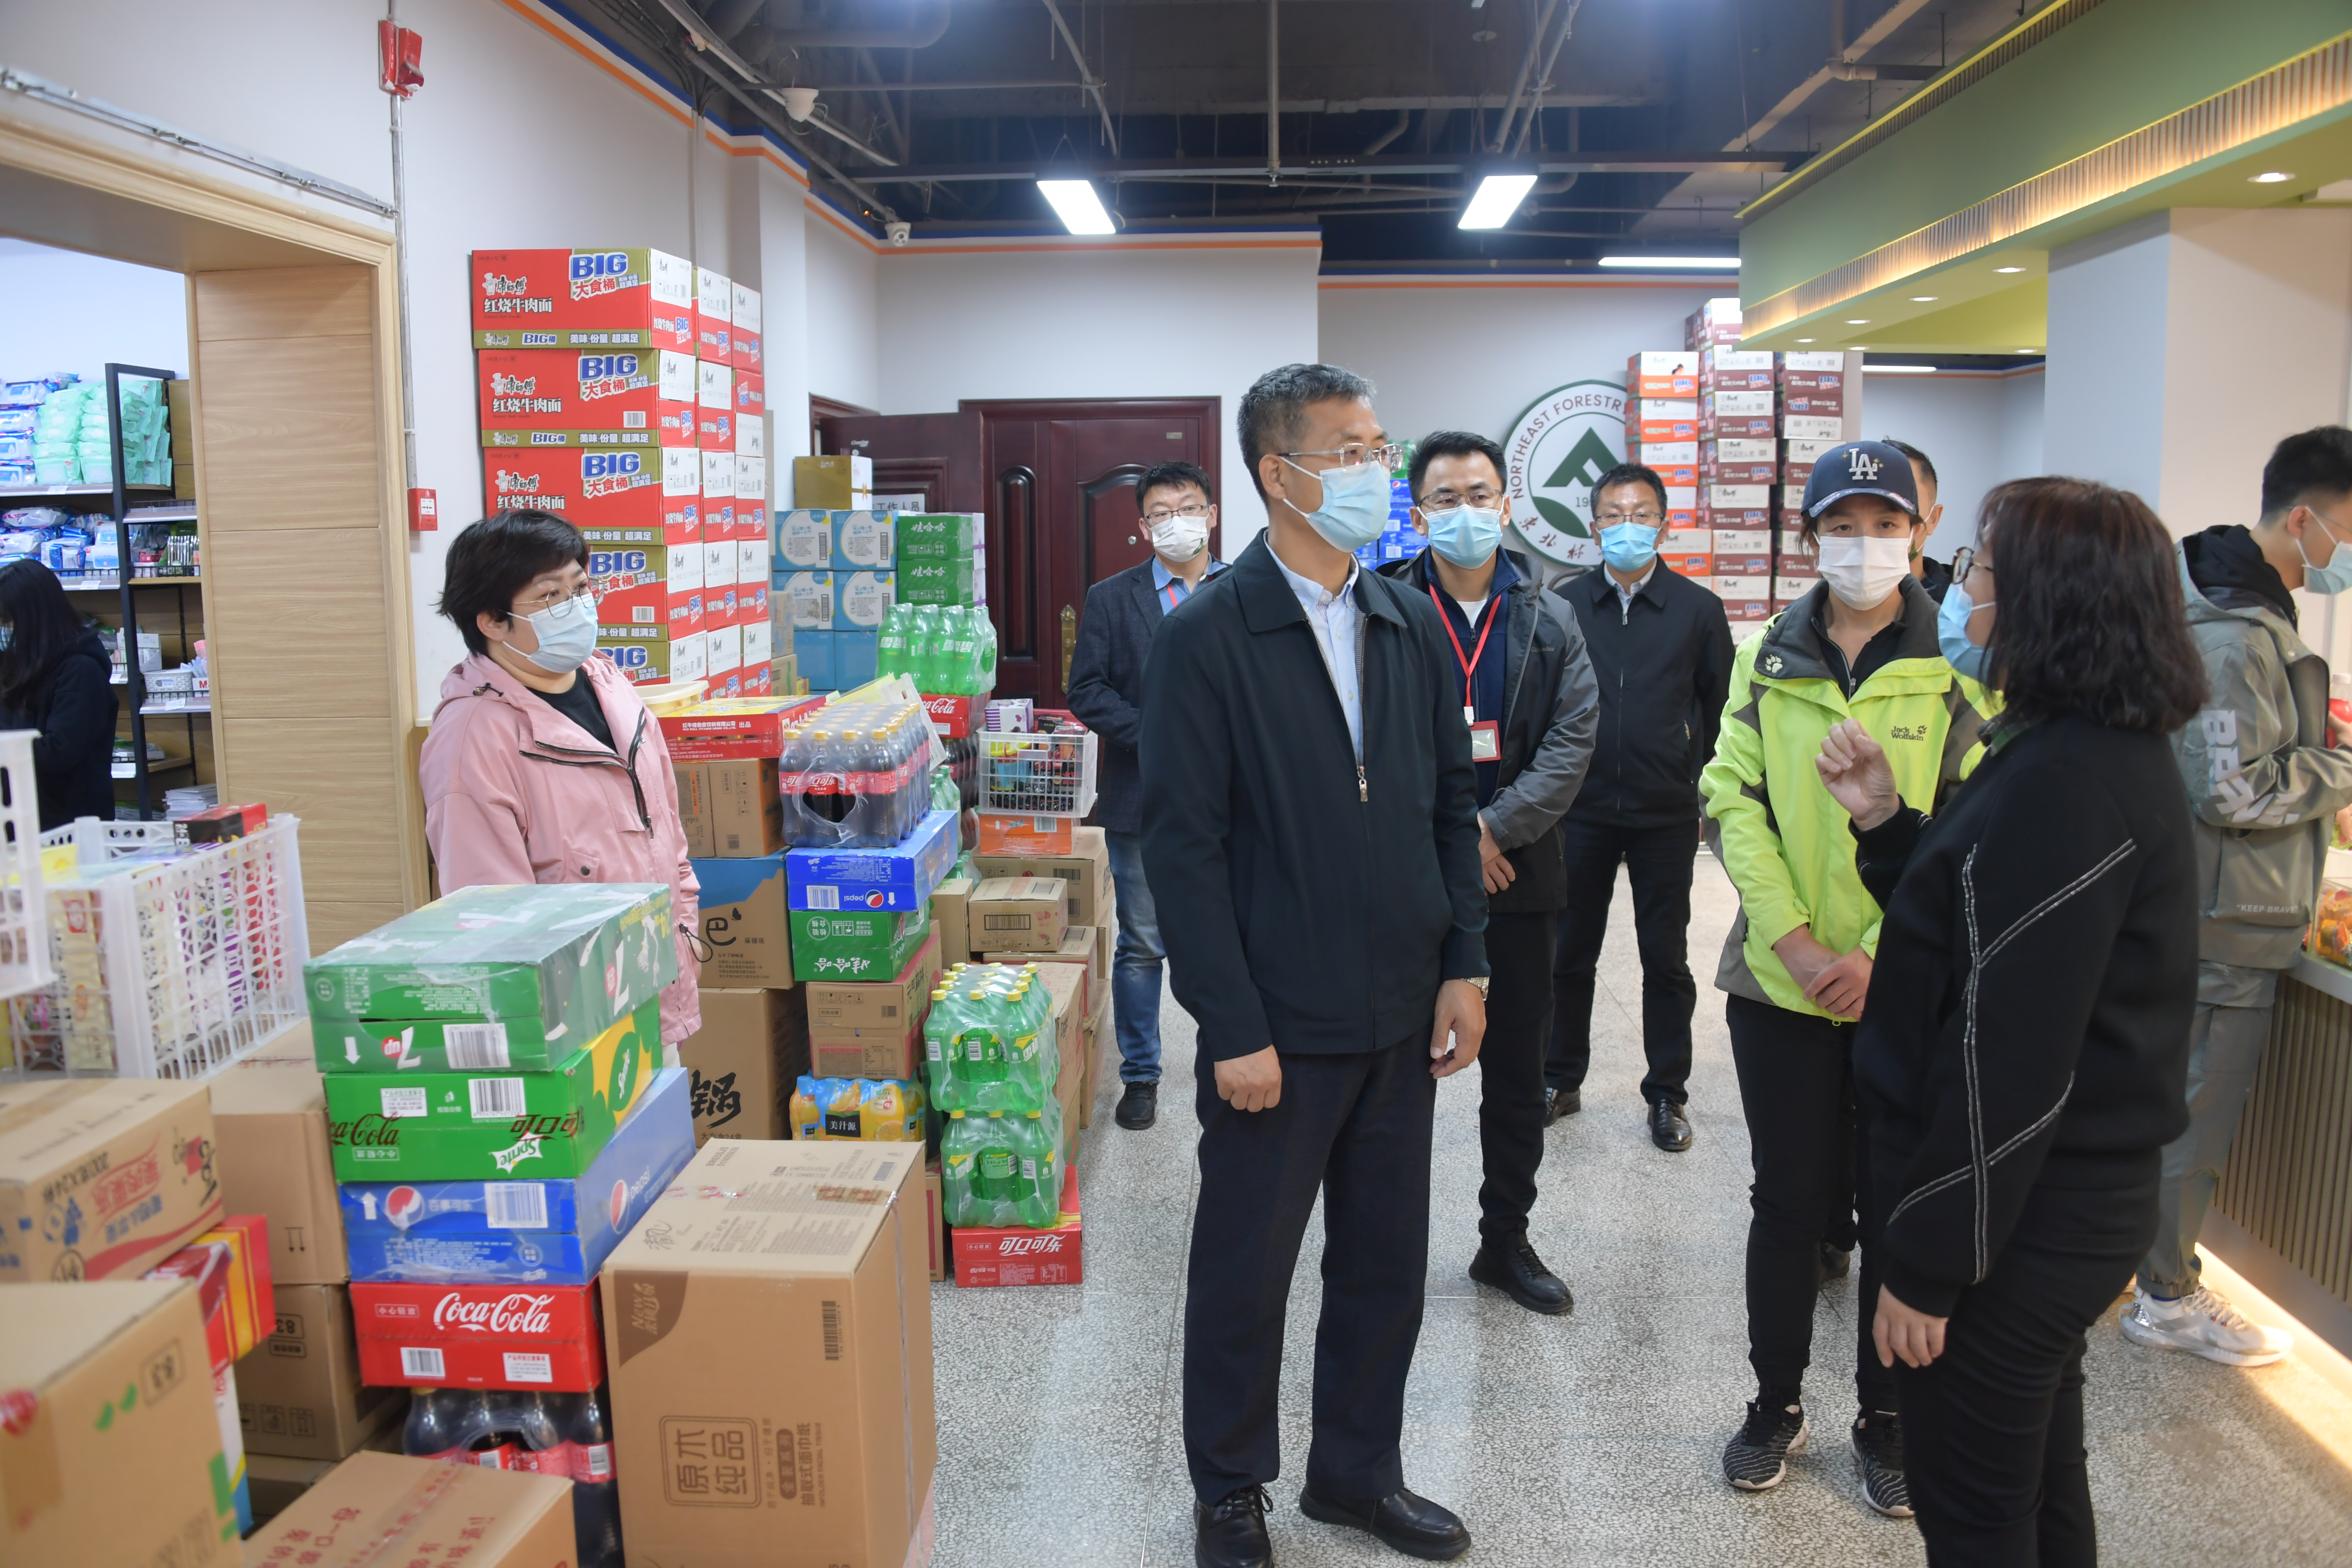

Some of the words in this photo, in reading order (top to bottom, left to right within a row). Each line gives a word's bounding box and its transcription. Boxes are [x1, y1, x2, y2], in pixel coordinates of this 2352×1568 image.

[571, 253, 627, 280] BIG
[574, 278, 616, 297] 大食桶
[619, 280, 639, 289] 超满足
[484, 297, 553, 313] 红烧牛肉面
[676, 317, 688, 332] BIG
[612, 333, 639, 343] 超满足
[719, 332, 727, 345] BIG
[580, 355, 637, 381] BIG
[585, 379, 626, 398] 大食桶
[629, 381, 649, 390] 超满足
[493, 398, 561, 413] 红烧牛肉面
[681, 411, 691, 426] BIG
[718, 417, 728, 430] BIG
[621, 433, 649, 443] 超满足
[1510, 410, 1550, 499] NORTHEAST
[583, 453, 640, 479] BIG
[1849, 448, 1878, 480] LA
[587, 477, 629, 496] 大食桶
[632, 479, 651, 487] 超满足
[497, 495, 565, 510] 红烧牛肉面
[685, 505, 696, 520] BIG
[722, 507, 732, 522] BIG
[754, 509, 763, 523] BIG
[911, 521, 946, 532] 娃哈哈
[624, 531, 652, 541] 超满足
[590, 552, 645, 576] BIG
[911, 566, 946, 577] 娃哈哈
[637, 576, 657, 585] 超满足
[726, 591, 735, 606] BIG
[756, 588, 765, 603] BIG
[690, 595, 700, 612] BIG
[596, 628, 628, 637] 味·份量
[631, 628, 658, 637] 超满足
[639, 672, 658, 681] 超满足
[759, 667, 768, 681] BIG
[727, 675, 738, 691] BIG
[1891, 732, 1923, 741] Wolfskin
[814, 957, 870, 974] 娃哈哈
[690, 1069, 741, 1129] 锅
[830, 1121, 857, 1131] 美汁源
[501, 1139, 536, 1166] Sprite
[999, 1234, 1067, 1256] 可口可乐
[379, 1307, 416, 1315] 小心轻放
[433, 1293, 555, 1333] Coca-Cola
[632, 1294, 645, 1329] New
[675, 1429, 709, 1494] 原木
[711, 1431, 747, 1494] 纯品
[797, 1423, 815, 1506] 抽取式面巾纸
